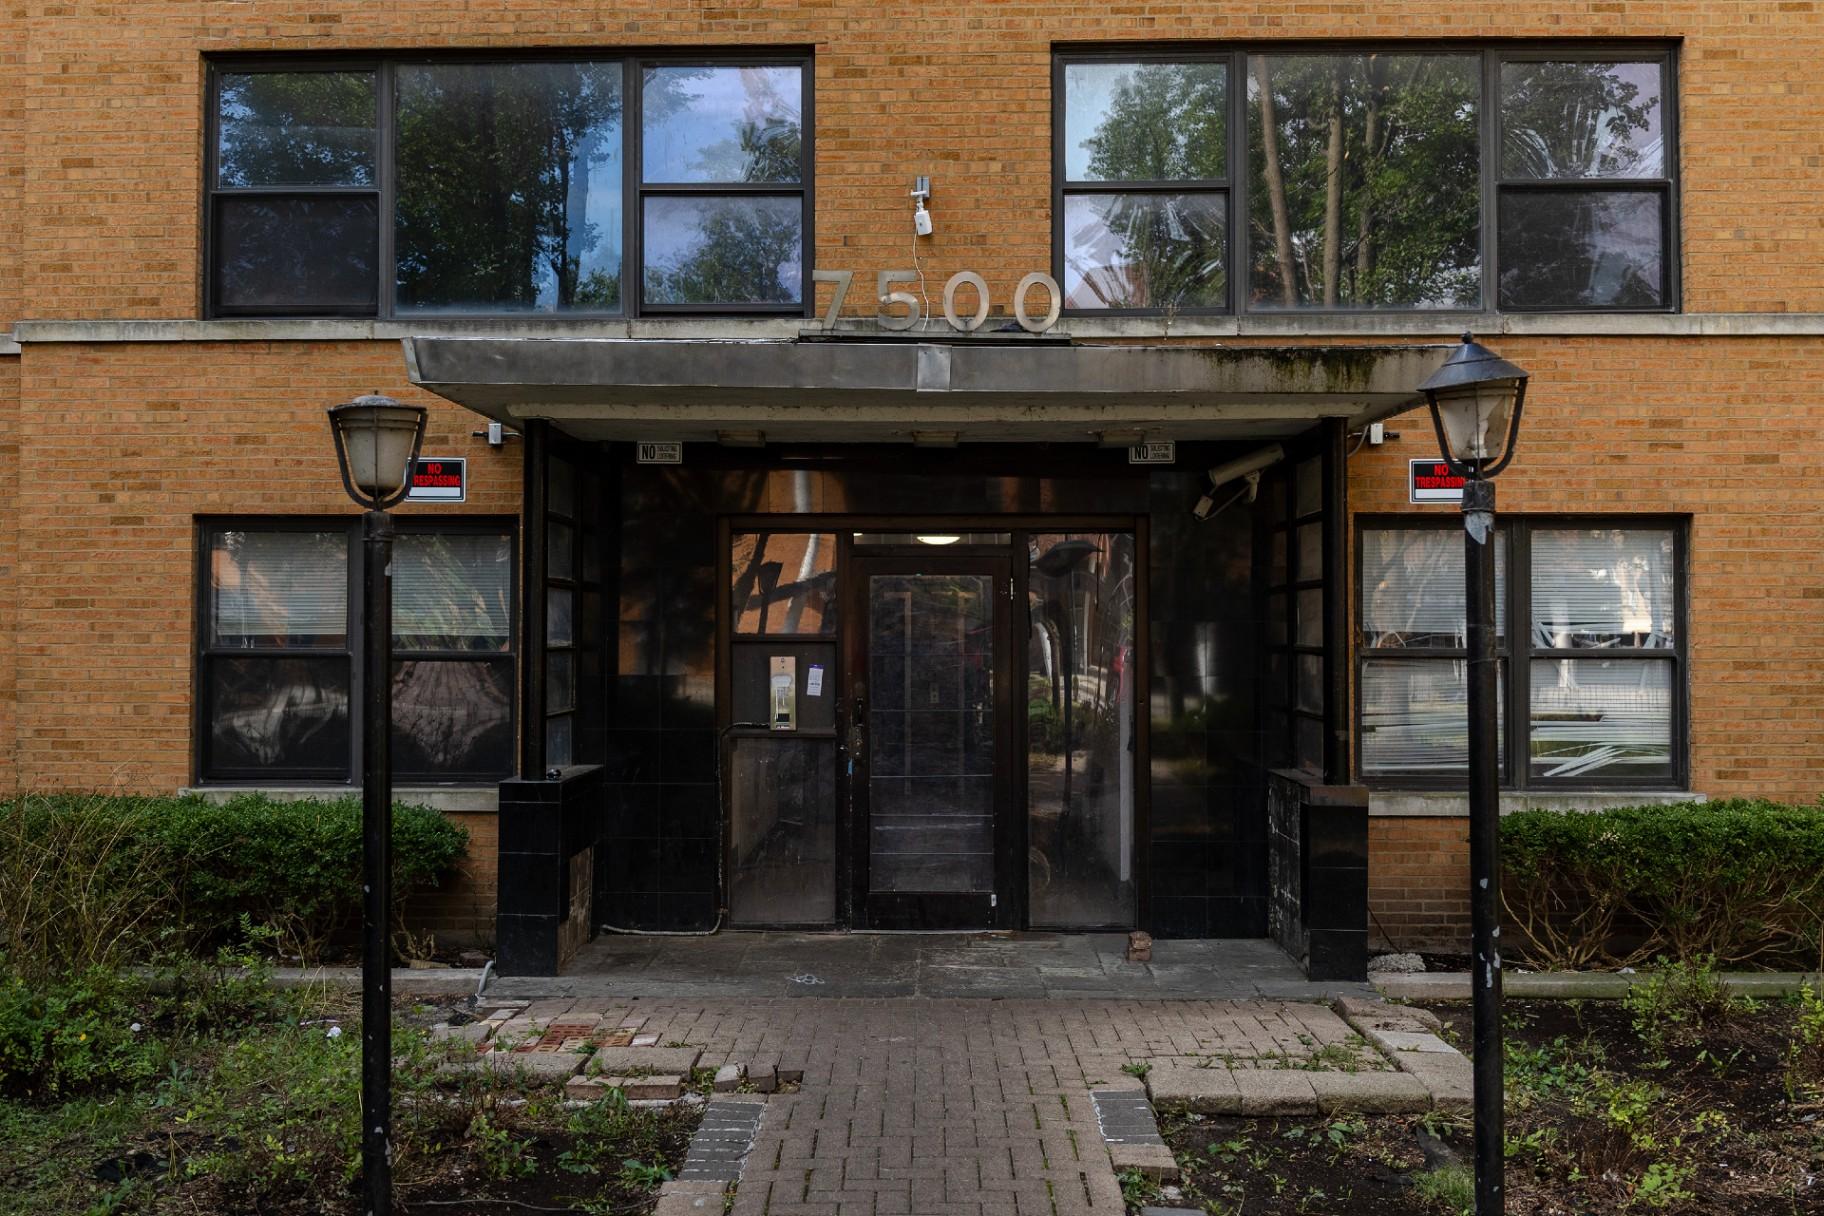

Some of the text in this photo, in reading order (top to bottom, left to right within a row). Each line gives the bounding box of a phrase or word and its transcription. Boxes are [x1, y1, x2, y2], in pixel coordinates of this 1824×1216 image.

[812, 270, 1061, 333] 7500
[641, 445, 656, 459] NO
[1134, 444, 1148, 459] NO
[427, 463, 442, 474] NO
[1433, 463, 1449, 476] NO
[413, 475, 461, 487] RESPASSING
[1415, 476, 1465, 489] TRESPASSIN
